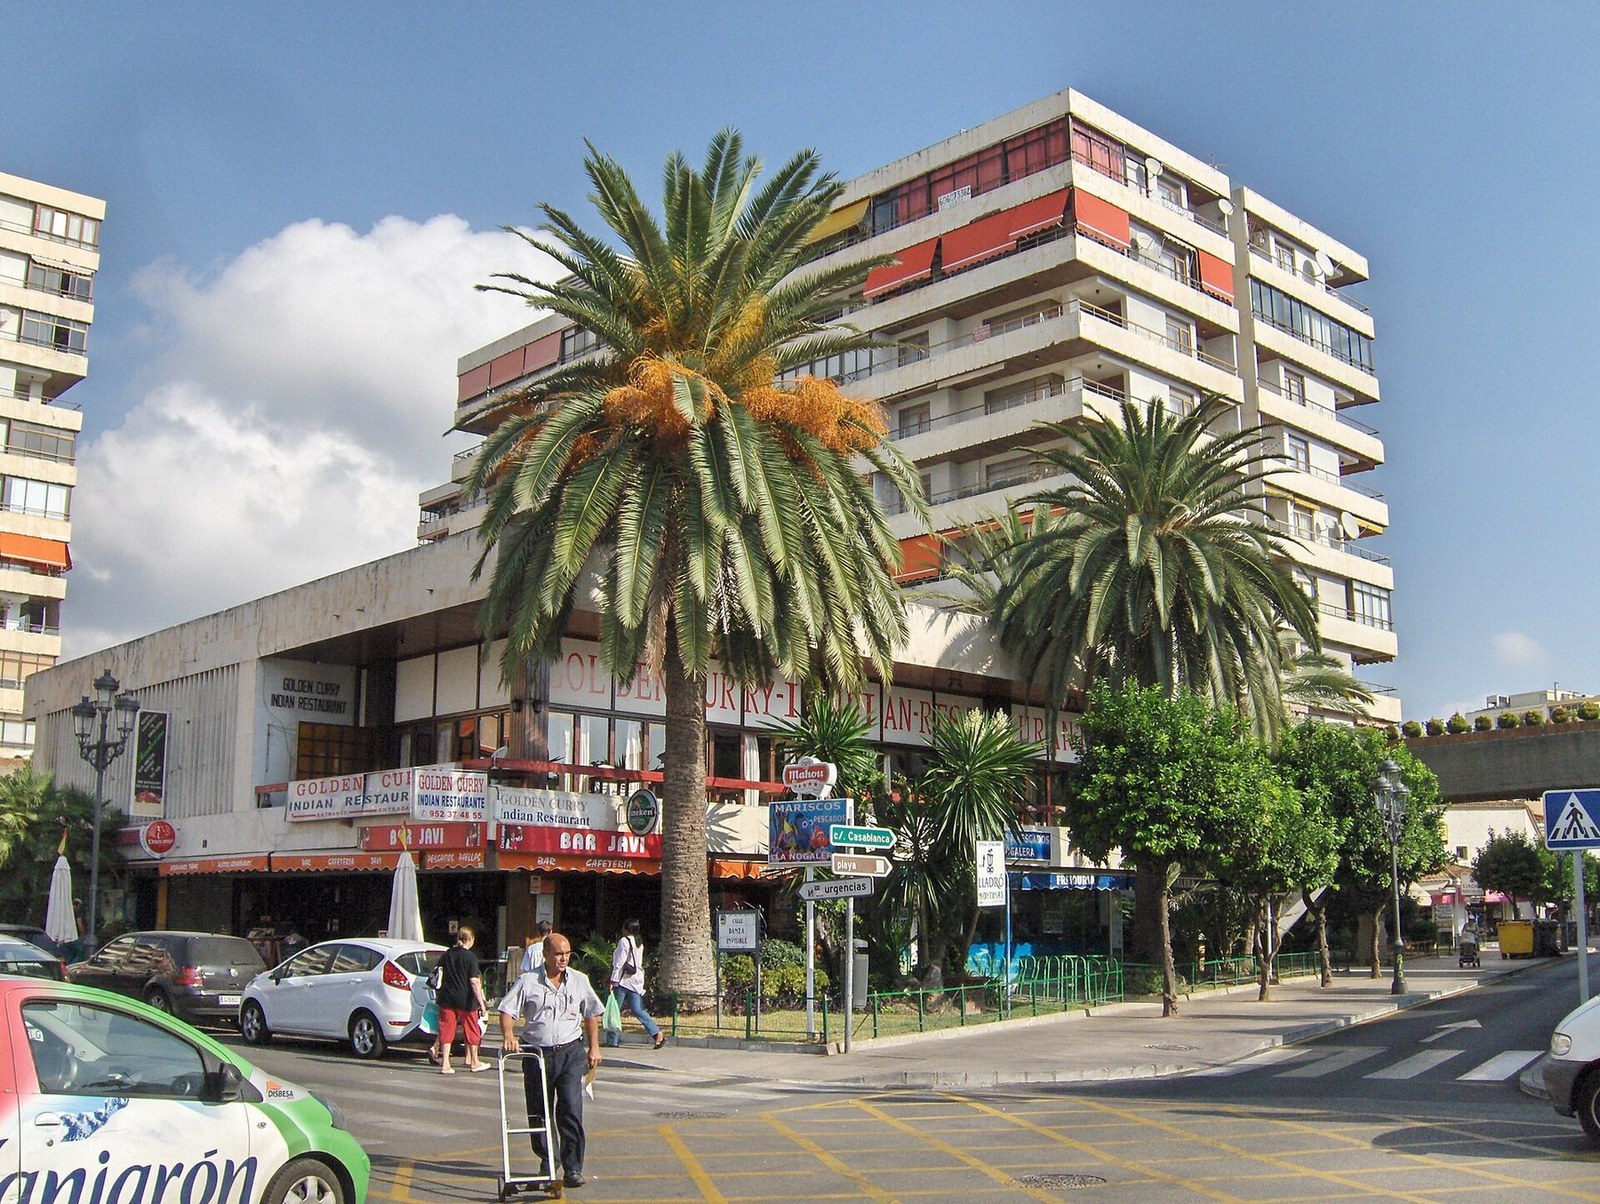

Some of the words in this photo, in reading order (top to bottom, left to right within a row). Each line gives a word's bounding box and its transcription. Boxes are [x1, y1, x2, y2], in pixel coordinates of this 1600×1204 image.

[549, 652, 667, 702] OLDEN
[283, 677, 313, 694] GOLDEN
[316, 681, 340, 697] CURRY
[270, 693, 295, 709] INDIAN
[297, 696, 346, 714] RESTAURANT
[296, 776, 363, 797] GOLDEN
[418, 774, 453, 791] GOLDEN
[456, 776, 484, 793] CURRY
[289, 798, 333, 812] INDIAN
[417, 794, 440, 806] INDIAN
[441, 795, 485, 809] RESTAURANTE
[501, 793, 546, 808] GOLDEN
[549, 796, 588, 812] CURRY
[775, 802, 841, 812] MARISCOS
[429, 810, 445, 818] 952
[460, 811, 470, 819] 48
[500, 808, 533, 822] ndian
[536, 811, 590, 826] Restaurant
[813, 815, 846, 823] PESCADOS
[389, 828, 412, 846] BR
[419, 828, 444, 844] JAVI
[560, 832, 596, 851] BAR
[608, 835, 645, 854] JAVI
[848, 832, 890, 844] Casablanca
[537, 856, 556, 866] BAR
[585, 858, 632, 869] CAFETERIA
[776, 852, 786, 860] LA
[789, 852, 832, 860] NOGALER
[837, 861, 857, 871] playa
[824, 883, 867, 896] urgencias
[267, 1090, 294, 1098] DISBESA
